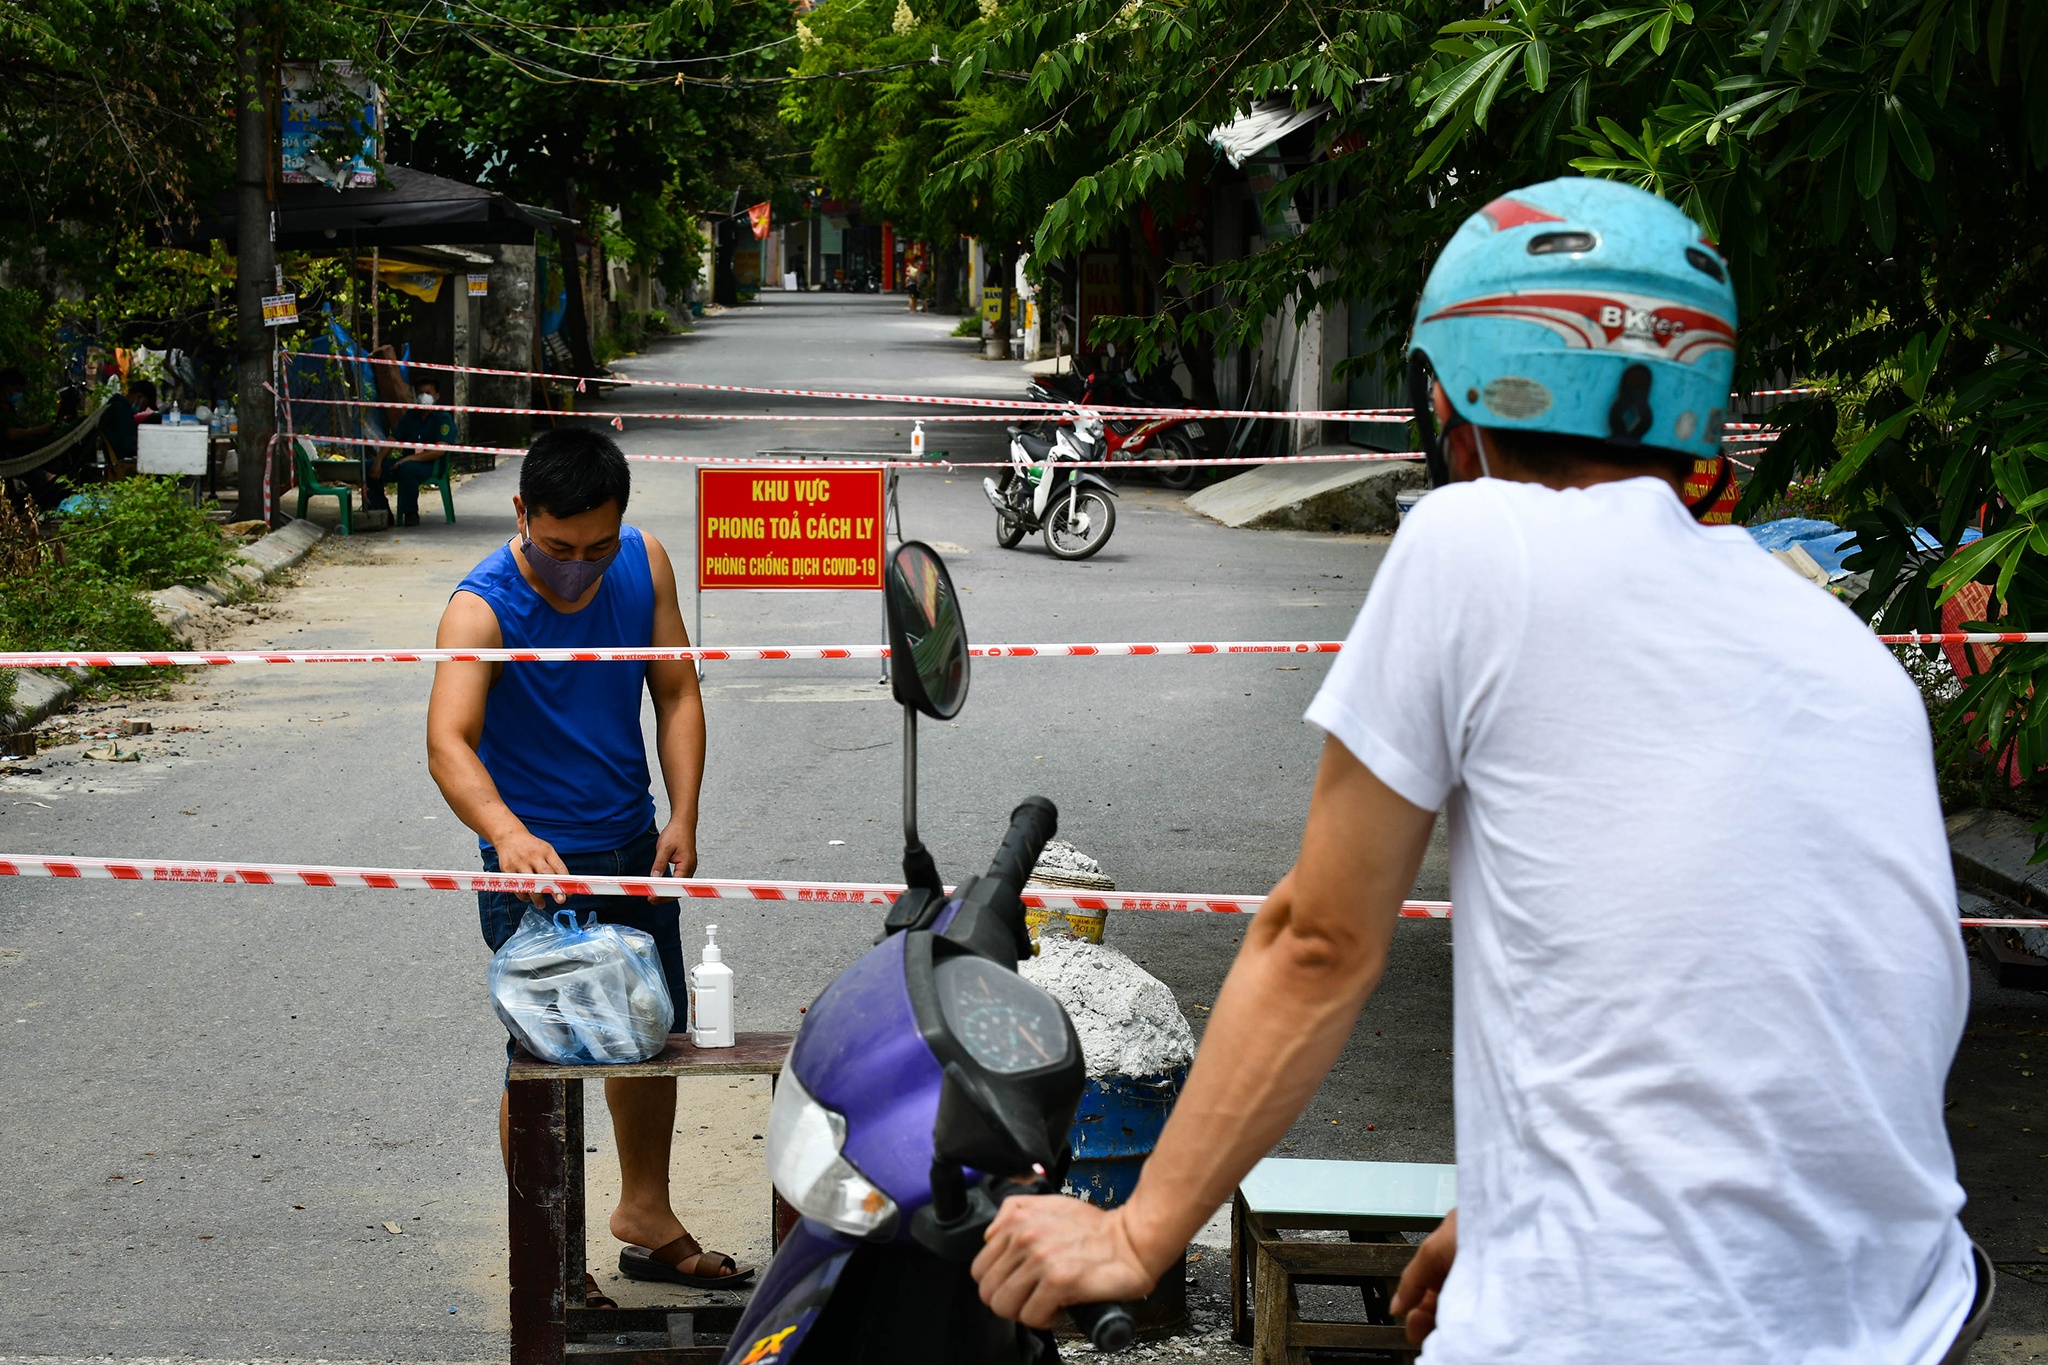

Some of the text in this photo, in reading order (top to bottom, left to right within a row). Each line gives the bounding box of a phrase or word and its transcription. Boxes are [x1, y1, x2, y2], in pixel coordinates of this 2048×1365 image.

[752, 478, 830, 506] KHU VỰC
[708, 510, 874, 539] PHONG TOẢ CÁCH LY
[706, 551, 876, 580] PHÒNG CHỐNG DỊCH COVID-19
